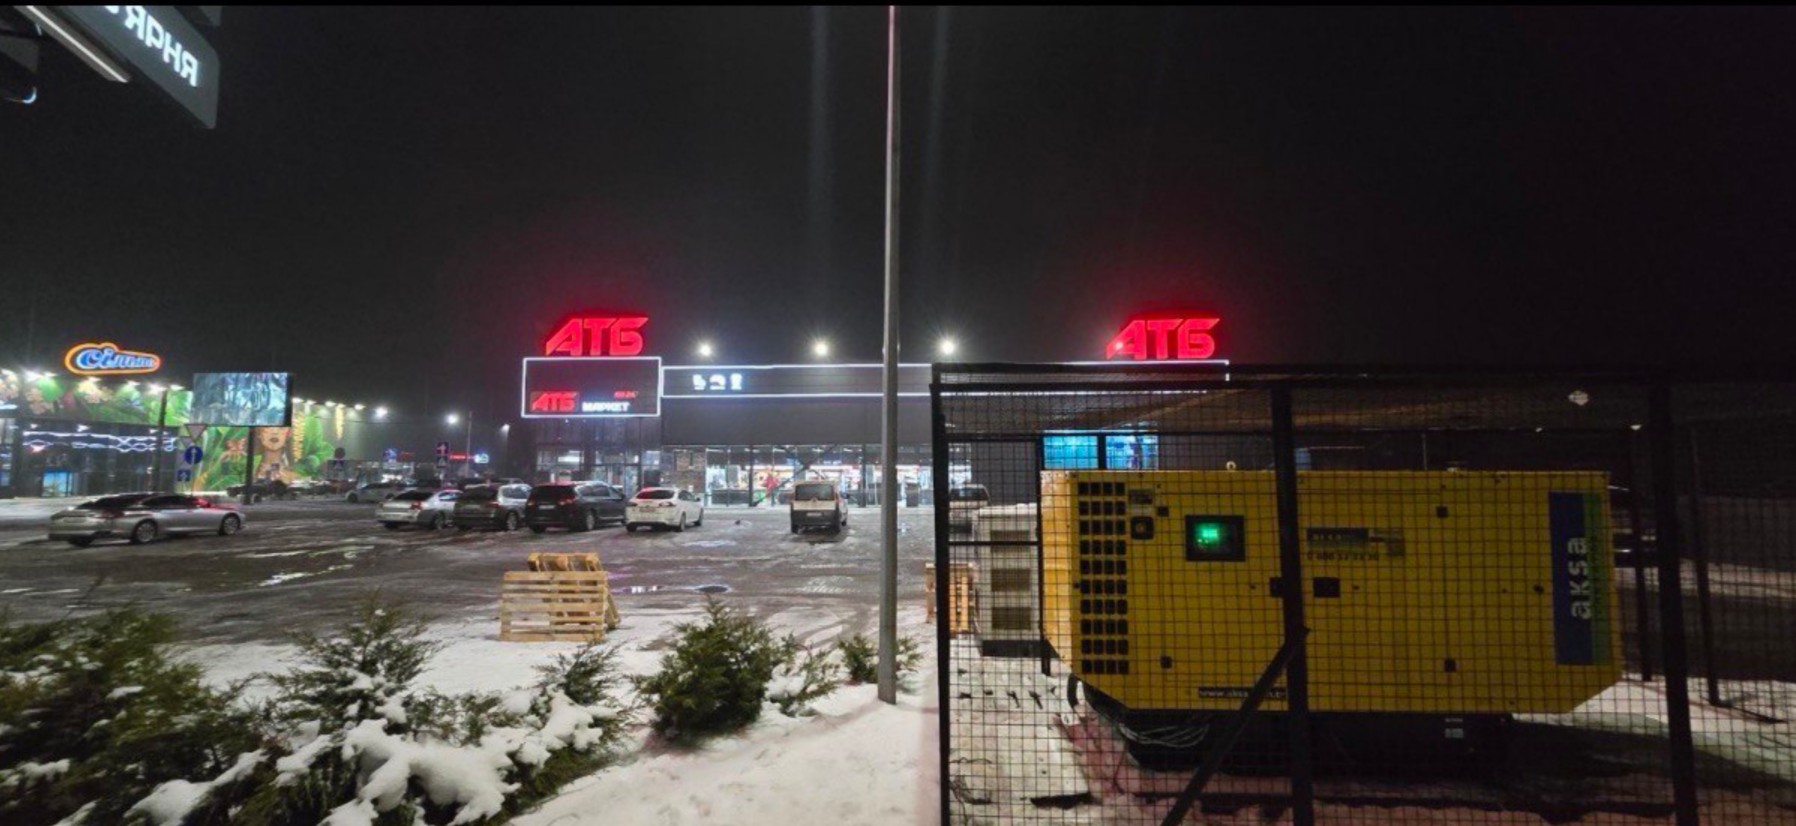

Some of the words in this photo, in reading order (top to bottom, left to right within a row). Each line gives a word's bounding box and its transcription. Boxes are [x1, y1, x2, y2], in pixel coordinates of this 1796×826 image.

[104, 6, 198, 87] ЯРНЯ
[545, 317, 649, 356] АТБ
[1106, 317, 1220, 360] АТБ
[532, 391, 577, 412] АТБ
[582, 401, 630, 412] МАРКЕТ
[1567, 537, 1593, 621] aksa
